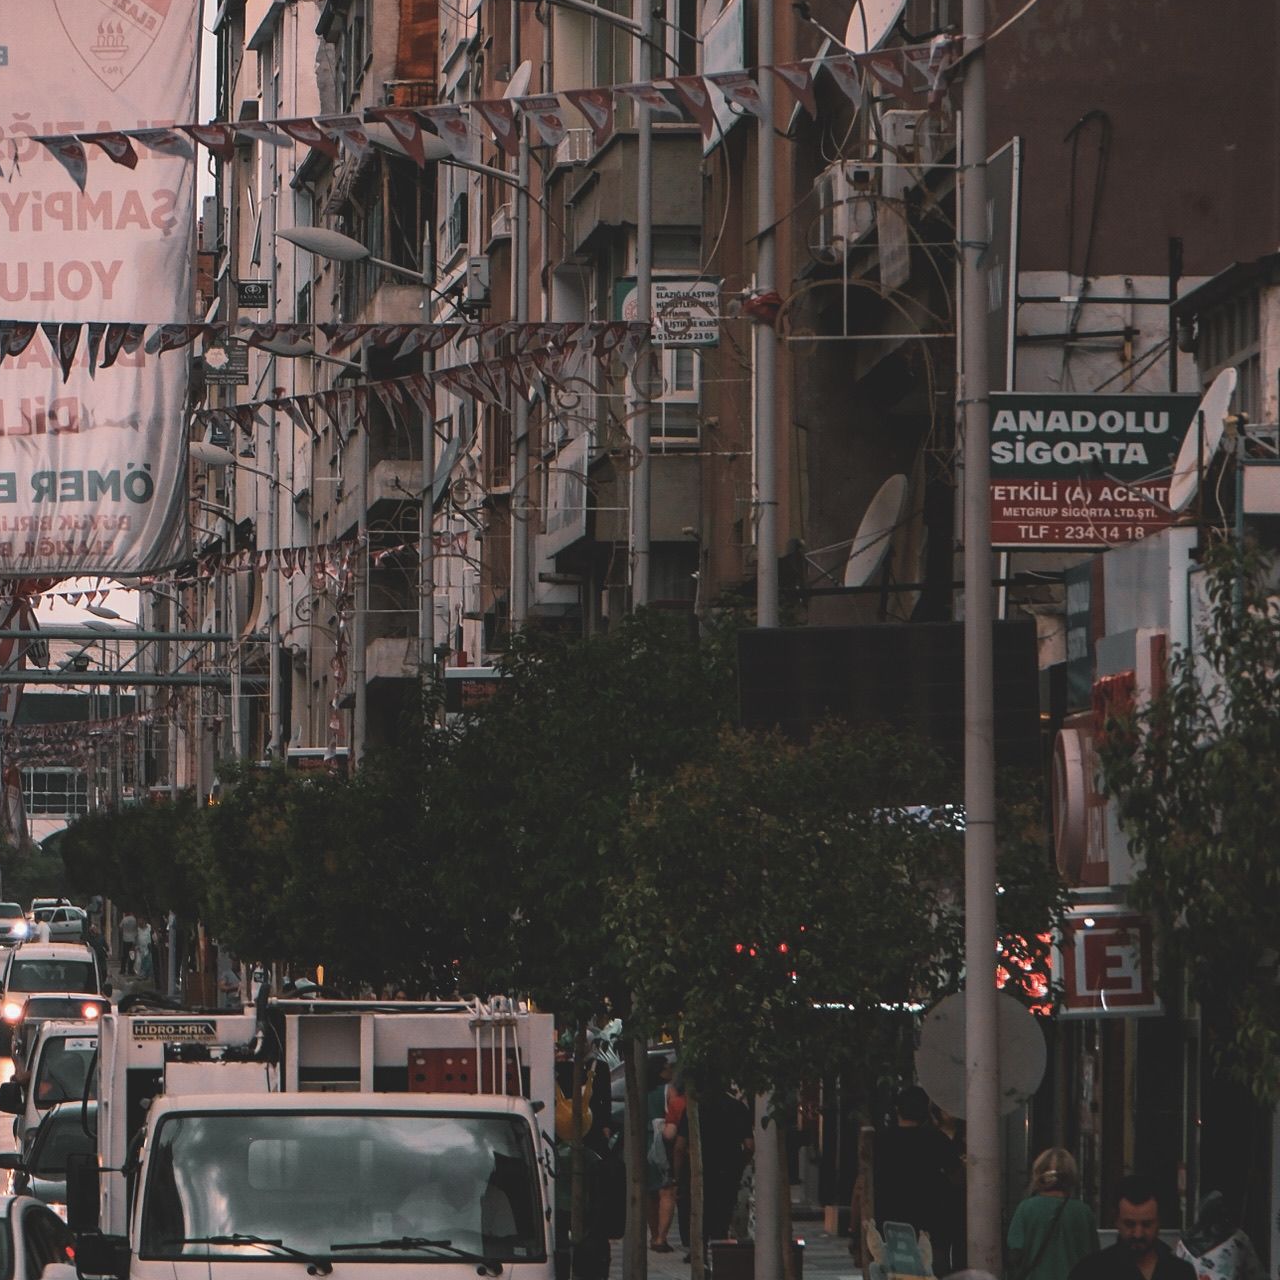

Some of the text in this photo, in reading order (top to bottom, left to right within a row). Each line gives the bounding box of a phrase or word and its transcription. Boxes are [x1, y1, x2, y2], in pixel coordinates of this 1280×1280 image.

[992, 410, 1170, 434] ANADOLU
[991, 434, 1149, 465] SİGORTA
[1065, 485, 1092, 505] (A)
[1098, 485, 1170, 503] ACENT
[1002, 507, 1059, 518] METGRUP
[1061, 505, 1111, 518] SİGORTA
[1018, 525, 1049, 539] TLF
[1064, 525, 1095, 539] 234
[1102, 525, 1120, 539] 14
[1125, 525, 1145, 539] 18
